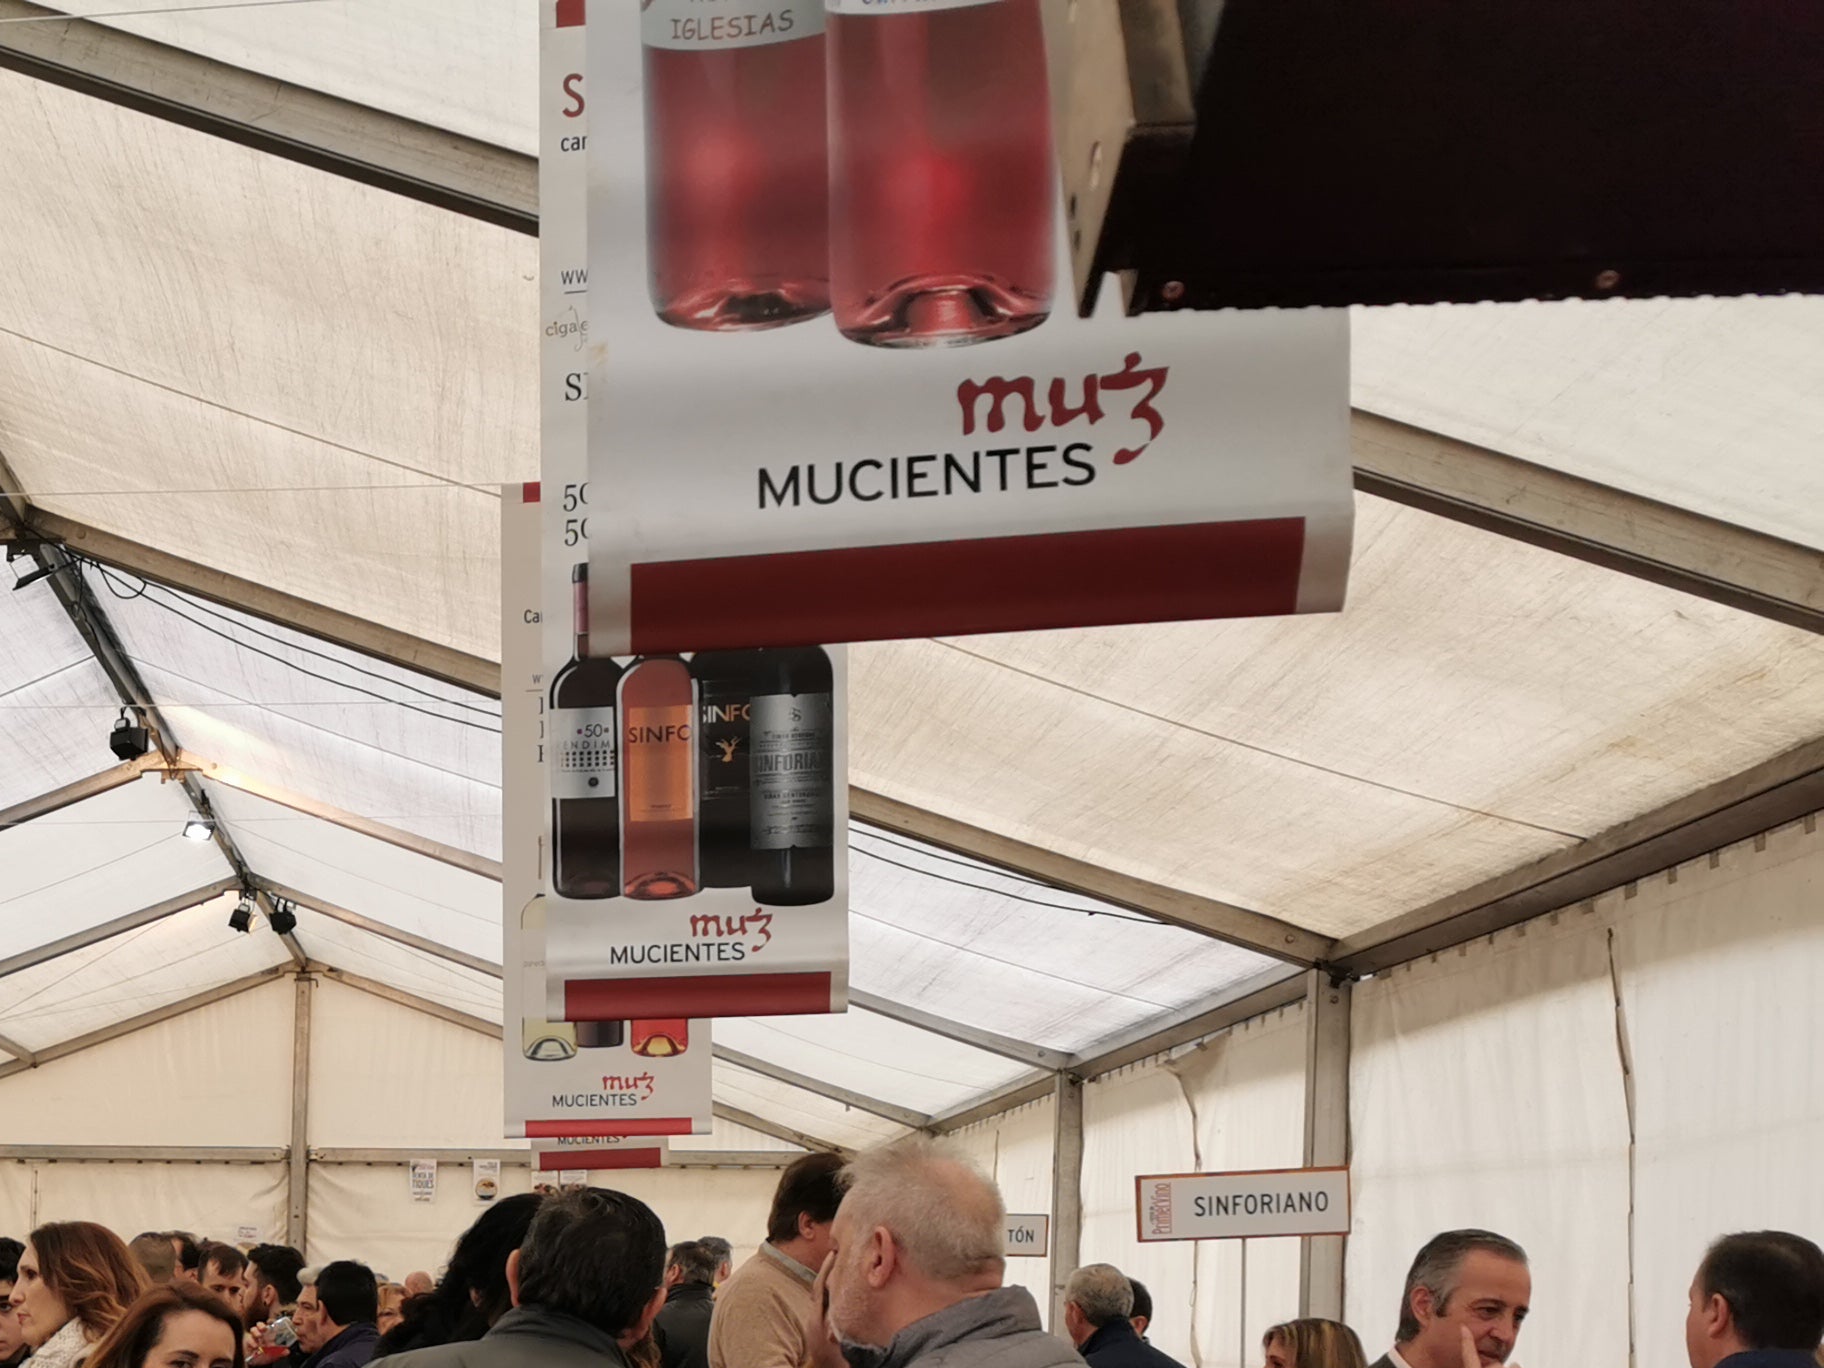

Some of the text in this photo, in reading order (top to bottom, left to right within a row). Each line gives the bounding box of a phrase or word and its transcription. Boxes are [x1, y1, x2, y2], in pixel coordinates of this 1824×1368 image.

[670, 9, 795, 42] IGLESIAS
[757, 441, 1098, 512] MUCIENTES
[609, 942, 746, 966] MUCIENTES
[552, 1094, 637, 1108] MUCIENTES
[1194, 1191, 1329, 1217] SINFORIANO
[1008, 1225, 1034, 1243] TÓN
